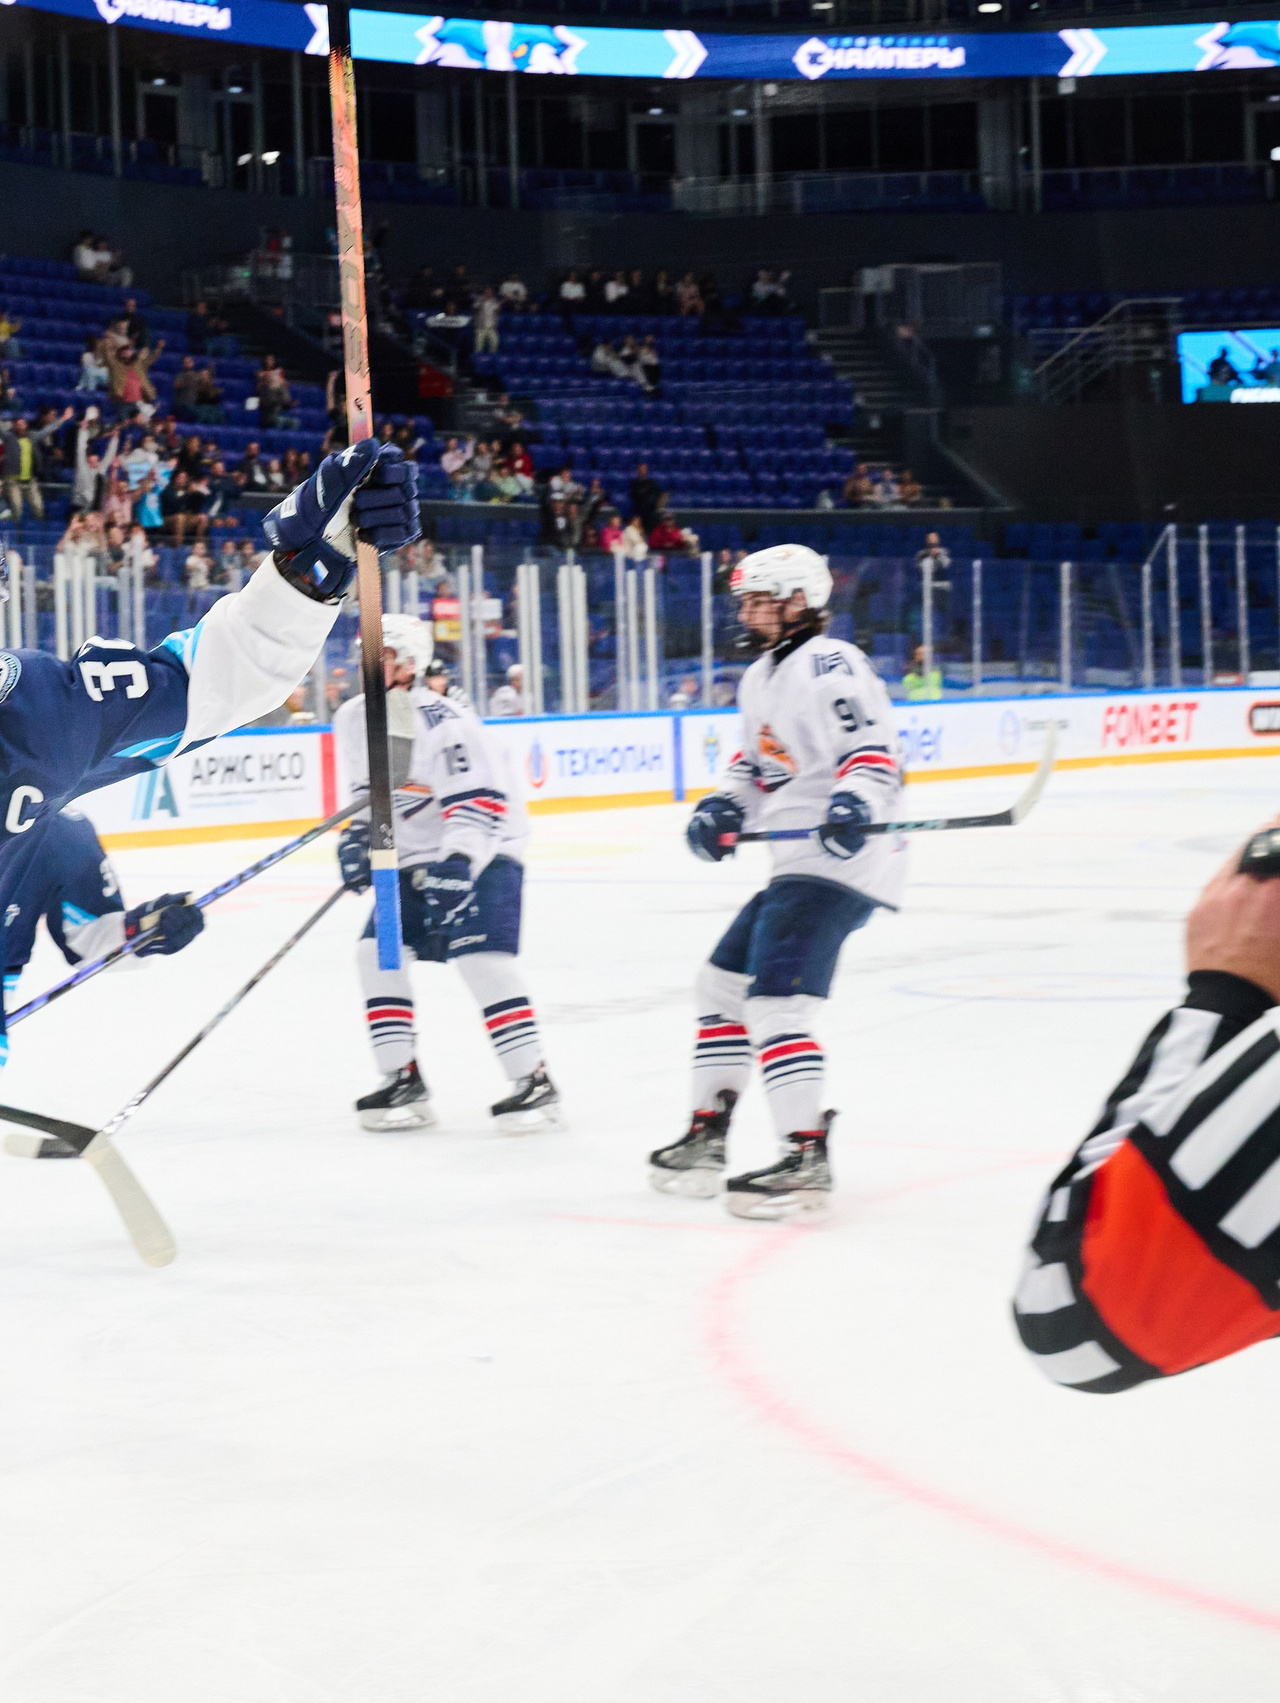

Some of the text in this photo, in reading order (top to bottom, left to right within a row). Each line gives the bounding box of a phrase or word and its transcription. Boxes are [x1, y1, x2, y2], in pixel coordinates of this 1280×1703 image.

[1102, 702, 1200, 748] FONBET
[260, 751, 305, 782] НСО
[5, 785, 44, 834] C
